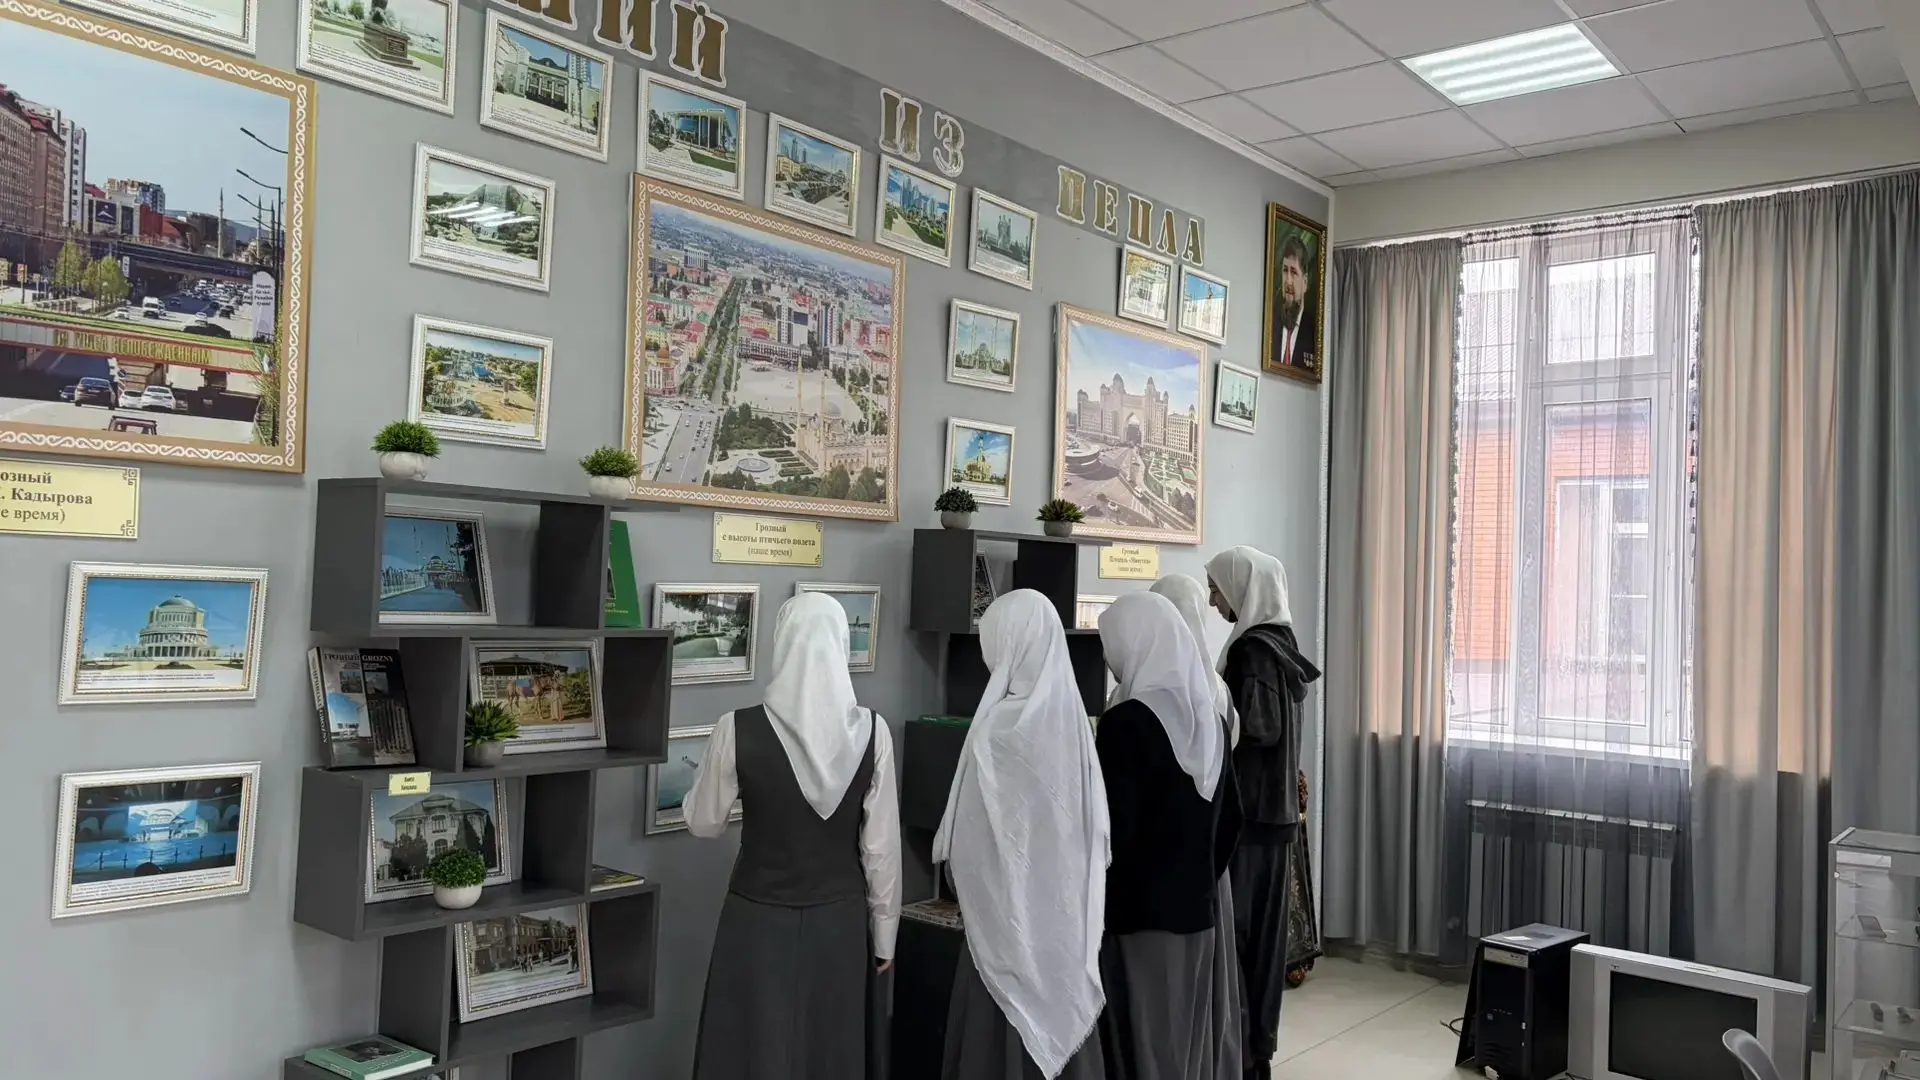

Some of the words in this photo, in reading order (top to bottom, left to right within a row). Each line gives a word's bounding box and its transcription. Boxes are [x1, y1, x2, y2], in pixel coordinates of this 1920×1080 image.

[879, 87, 965, 178] ИЗ
[1057, 165, 1205, 267] ПЕПЛА
[11, 487, 93, 506] Кадырова
[14, 509, 66, 525] время)
[755, 522, 787, 533] Грозный
[728, 534, 758, 543] высоты
[759, 536, 792, 545] птичьего
[747, 547, 769, 557] (наше
[770, 548, 793, 558] время)
